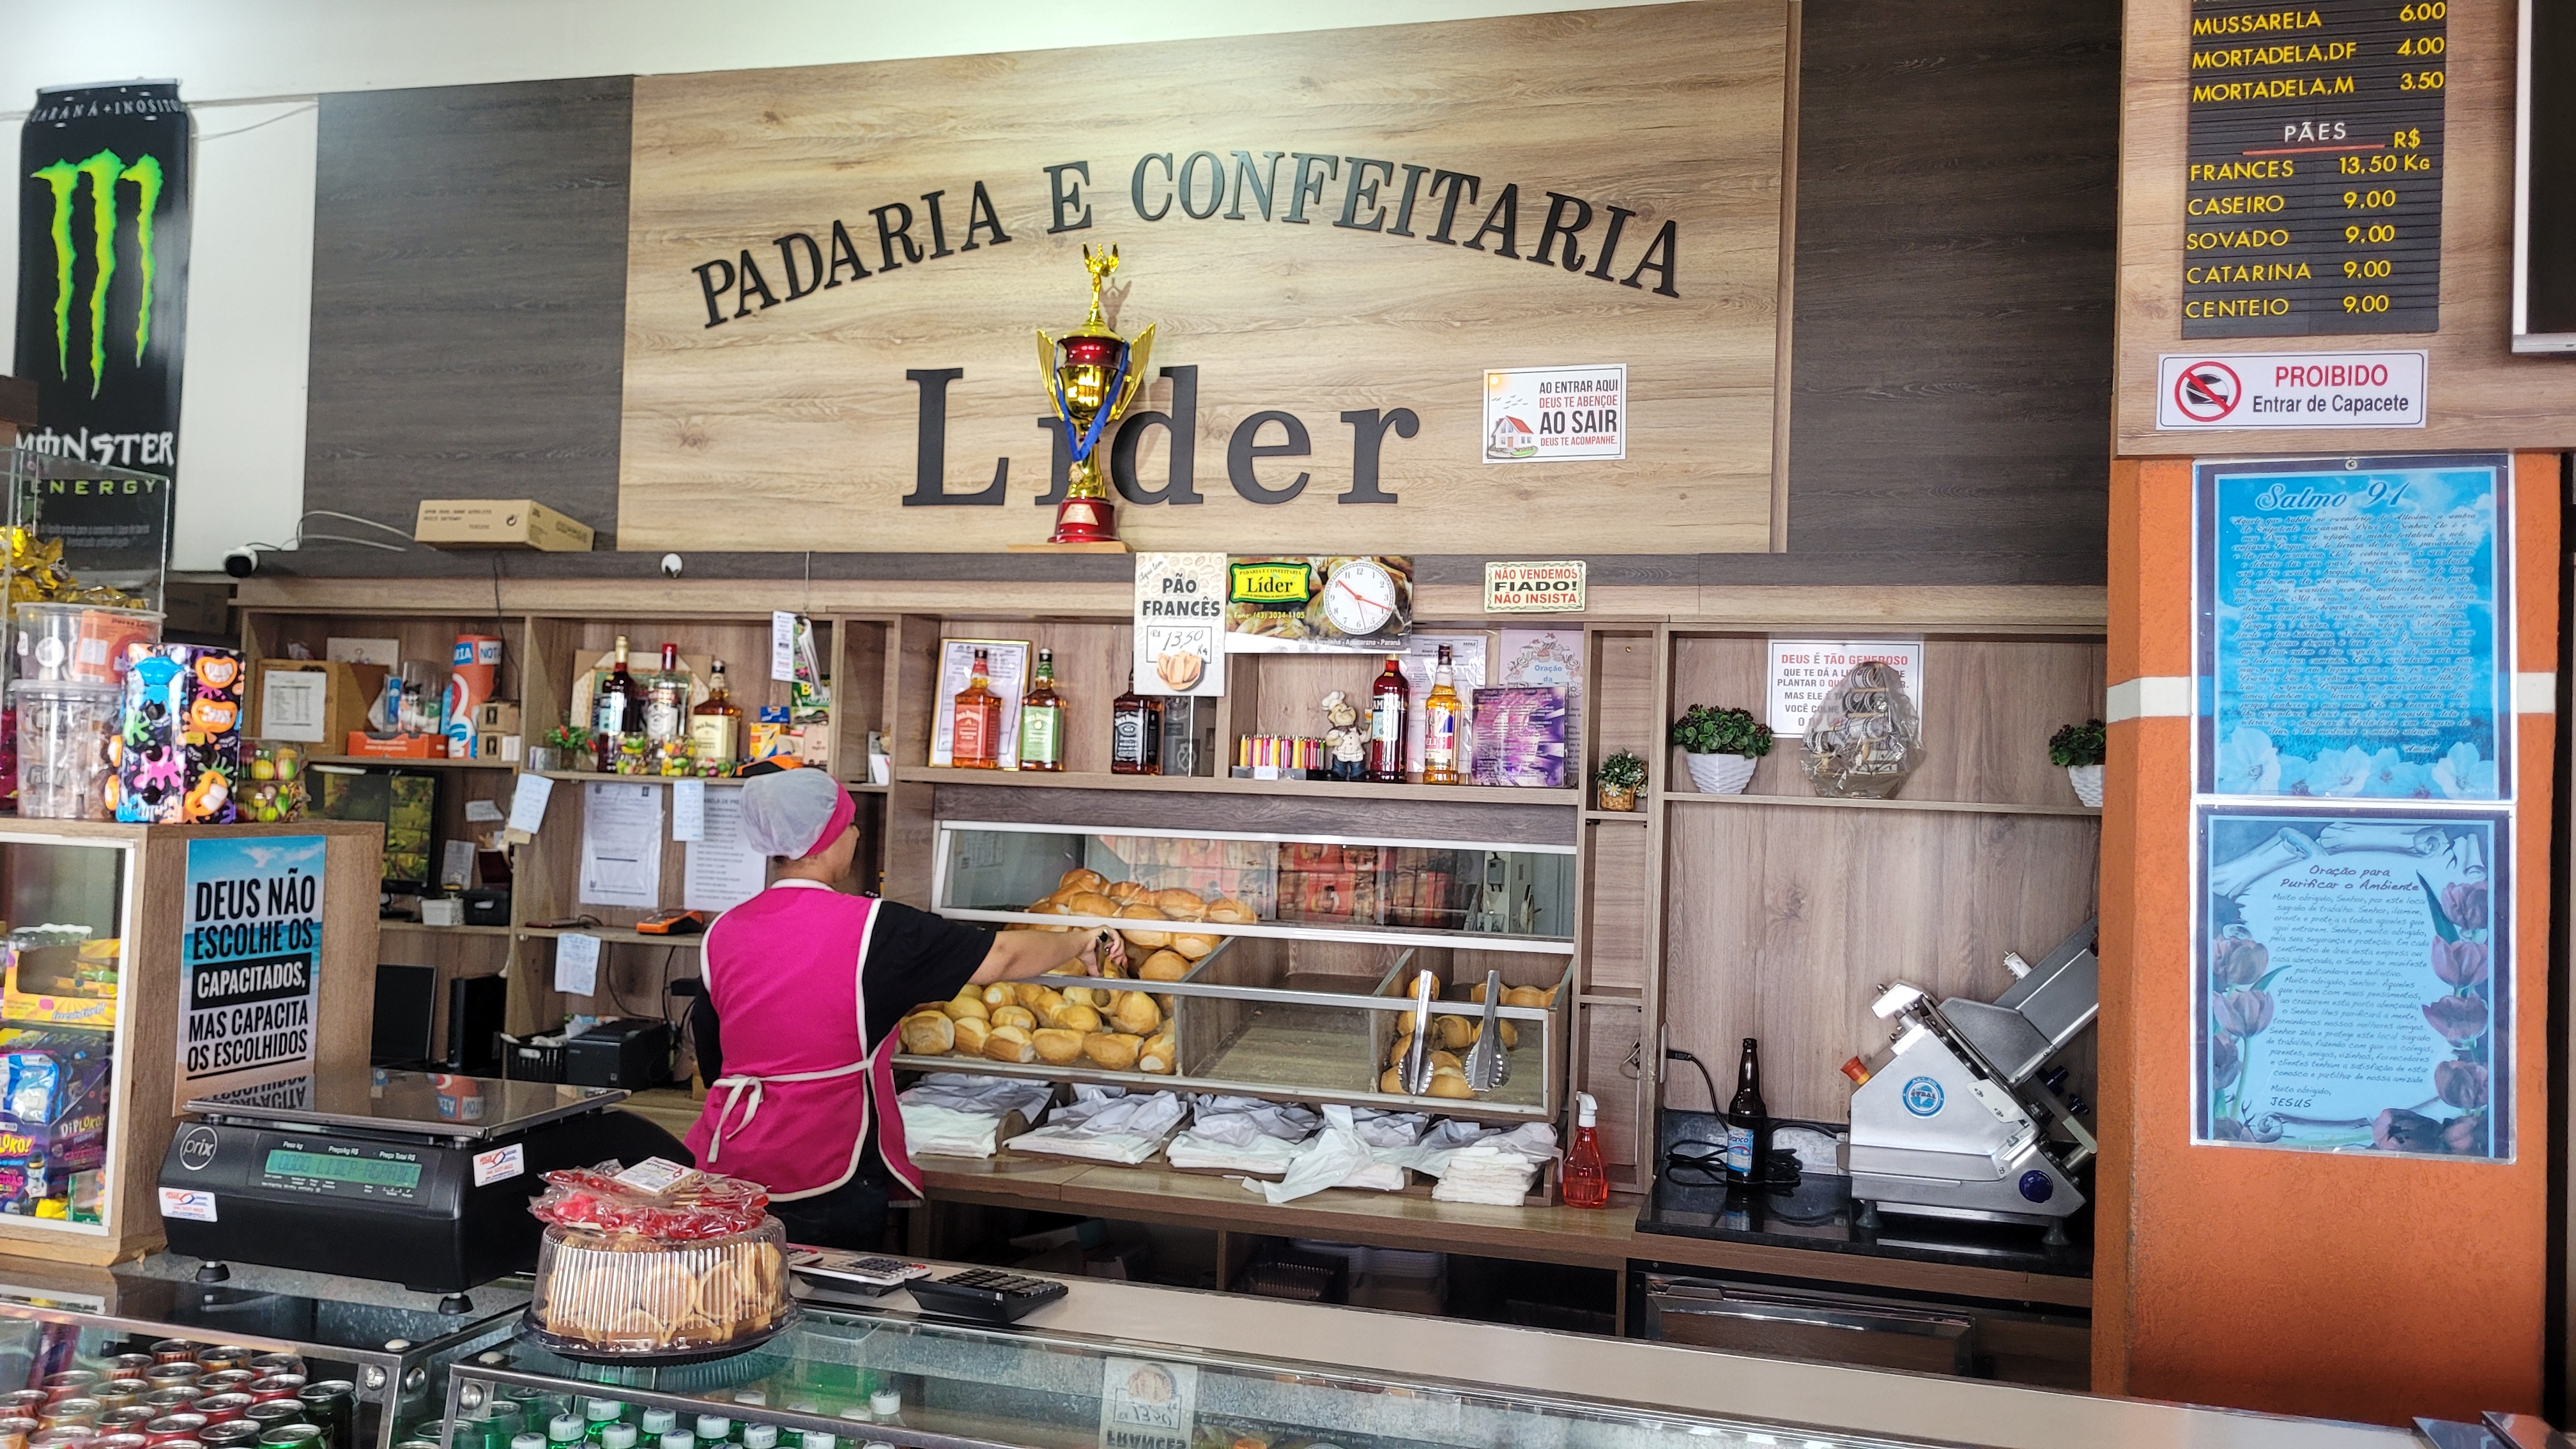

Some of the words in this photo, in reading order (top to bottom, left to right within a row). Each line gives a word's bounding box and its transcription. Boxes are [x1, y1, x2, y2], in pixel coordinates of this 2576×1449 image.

[2193, 10, 2322, 36] MUSSARELA
[2284, 121, 2346, 142] PÃES
[2394, 128, 2421, 150] R$
[2190, 160, 2294, 181] FRANCES
[2339, 154, 2397, 174] 13,50
[2188, 195, 2284, 216] CASEIRO
[692, 180, 1011, 329] PADARIA
[1043, 161, 1091, 234] E
[1130, 150, 1680, 298] CONFEITARIA
[2186, 229, 2289, 250] SOVADO
[2186, 263, 2312, 284] CATARINA
[2186, 298, 2289, 319] CENTEIO
[1539, 382, 1552, 394] AO
[1555, 380, 1593, 393] ENTRAR
[1595, 379, 1618, 392] AQUI
[2275, 365, 2388, 387] PROIBIDO
[1539, 397, 1561, 408] DEUS
[1564, 397, 1575, 407] TE
[1577, 395, 1618, 408] ABENÇOE
[2253, 395, 2302, 413] Entrar
[2306, 395, 2326, 412] de
[2332, 394, 2408, 416] Capacete
[1539, 411, 1565, 434] AO
[1572, 410, 1617, 433] SAIR
[16, 425, 174, 467] MONSTER
[1540, 438, 1559, 446] DEUS
[1561, 437, 1569, 445] TE
[1571, 436, 1617, 445] ACOMPANHE.
[31, 480, 157, 494] ENERGY
[2256, 484, 2347, 510] Salmo
[2365, 481, 2411, 507] 91
[1163, 573, 1197, 594] PÃO
[1495, 567, 1516, 579] NÃO
[1520, 569, 1577, 579] VENDEMOS
[1246, 576, 1293, 593] Líder
[1495, 581, 1577, 592] FIADO!
[1142, 596, 1220, 617] FRANCÊS
[1494, 592, 1521, 604] NÃO
[1526, 594, 1576, 603] INSISTA
[1162, 630, 1203, 650] 13,50
[480, 647, 498, 658] NOT
[1782, 655, 1809, 664] DEUS
[1814, 652, 1820, 664] É
[1824, 653, 1844, 664] TÃO
[1784, 669, 1800, 677] QUE
[1818, 668, 1829, 677] DÁ
[1785, 704, 1808, 712] VOCÊ
[1798, 717, 1804, 726] O
[2310, 864, 2356, 877] Oração
[2360, 868, 2390, 878] para
[195, 878, 261, 921] DEUS
[268, 868, 315, 916] NÃO
[2280, 878, 2338, 889] Purificar
[2359, 879, 2419, 891] Ambiente
[193, 920, 284, 960] ESCOLHE
[289, 917, 312, 950] OS
[197, 961, 306, 999] CAPACITADOS,
[188, 1010, 226, 1043] MAS
[231, 999, 307, 1036] CAPACITA
[187, 1044, 209, 1073] OS
[214, 1029, 307, 1068] ESCOLHIDOS
[2297, 1087, 2331, 1096] obrigado,
[2271, 1097, 2312, 1108] JESUS
[183, 1138, 214, 1156] prix
